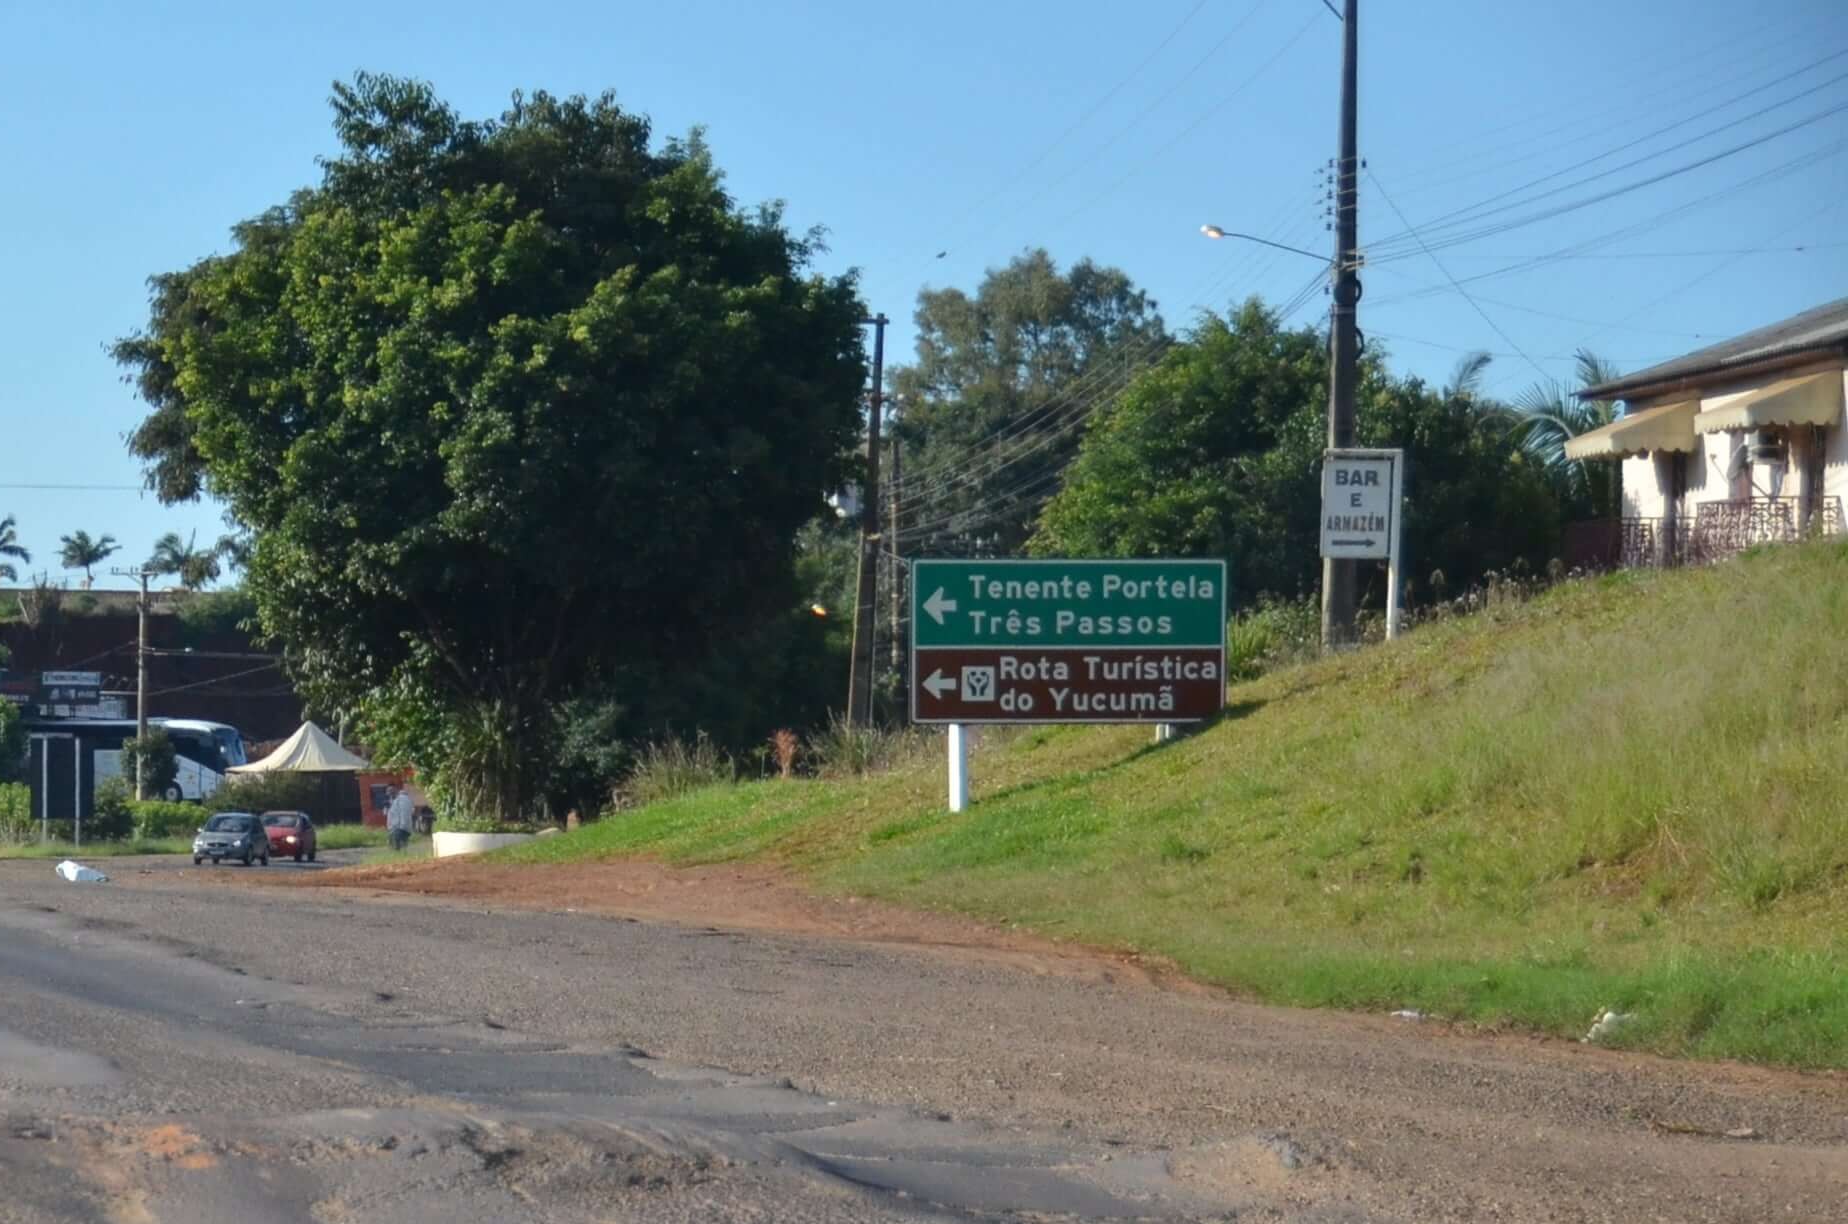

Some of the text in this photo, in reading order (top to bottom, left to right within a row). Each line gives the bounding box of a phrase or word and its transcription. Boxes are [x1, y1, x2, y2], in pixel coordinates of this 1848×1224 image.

[1336, 470, 1379, 486] BAR
[1351, 493, 1363, 507] E
[1327, 513, 1384, 531] ARMAZÉM
[969, 575, 1214, 599] Tenente Portela
[969, 609, 1172, 634] Três Passos
[1000, 655, 1217, 680] Rota Turística
[1000, 685, 1174, 711] do Yucumã
